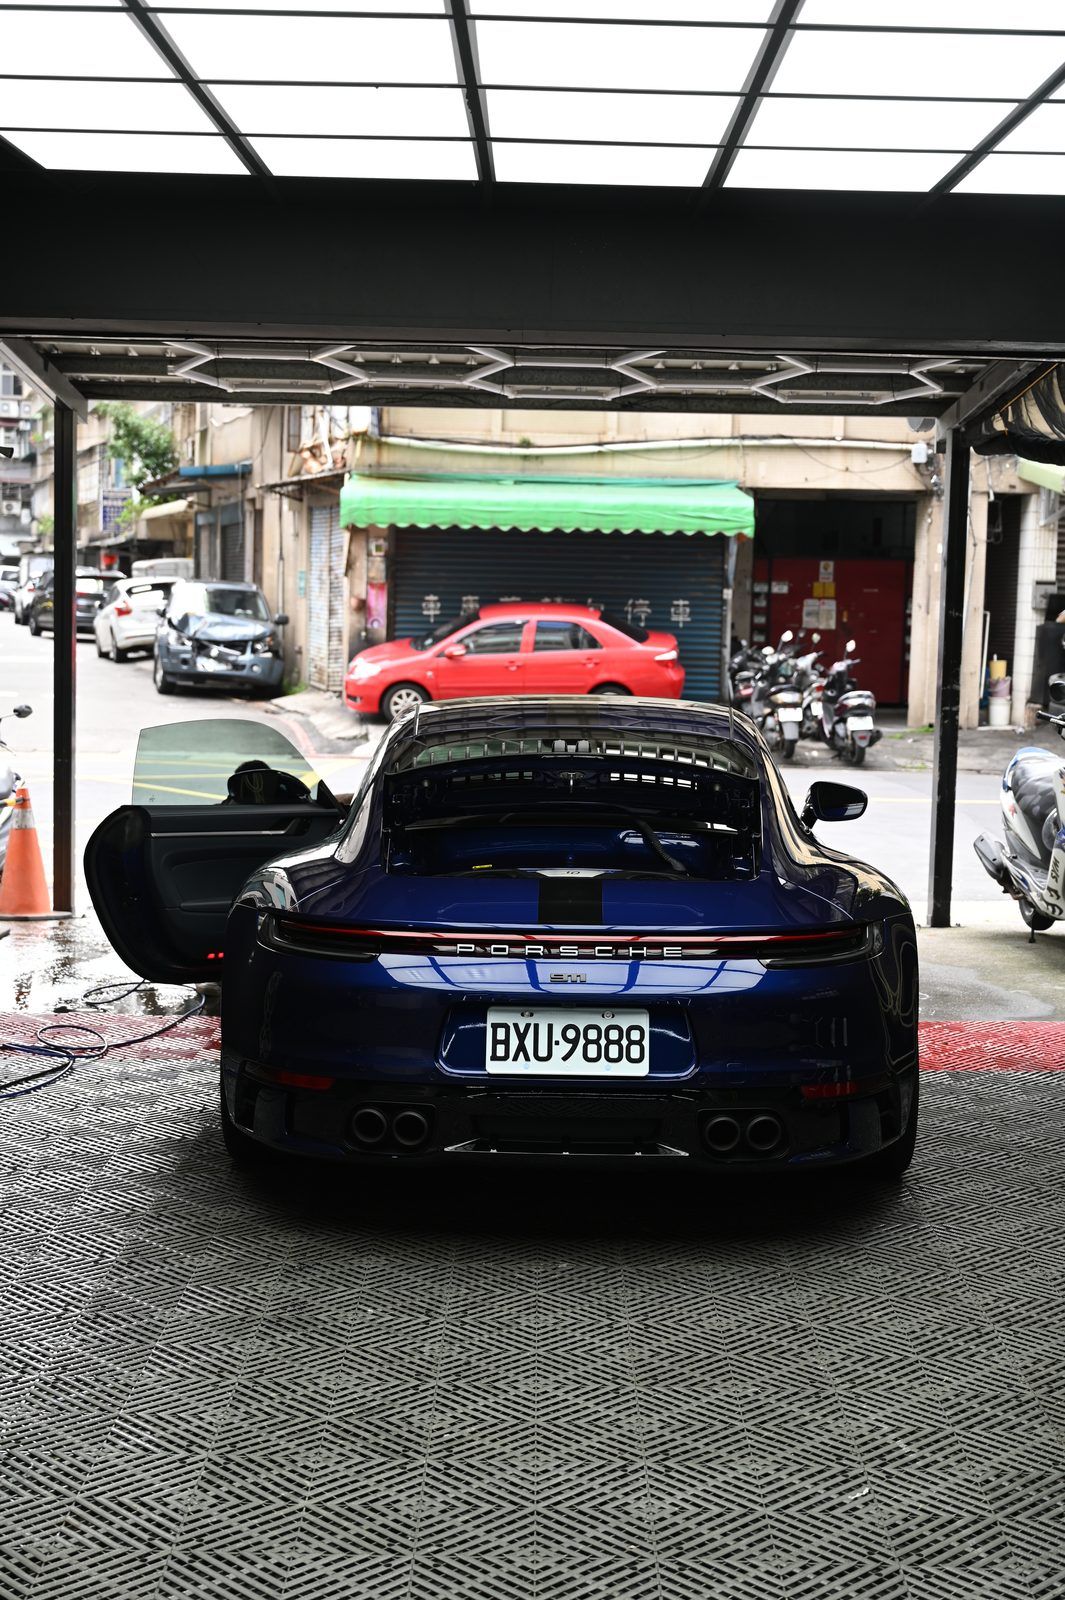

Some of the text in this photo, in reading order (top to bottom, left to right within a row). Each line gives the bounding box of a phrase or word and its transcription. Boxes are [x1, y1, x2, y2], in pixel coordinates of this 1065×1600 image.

[1050, 855, 1060, 884] SYM
[456, 943, 682, 957] PORSCHE
[549, 972, 587, 983] 911
